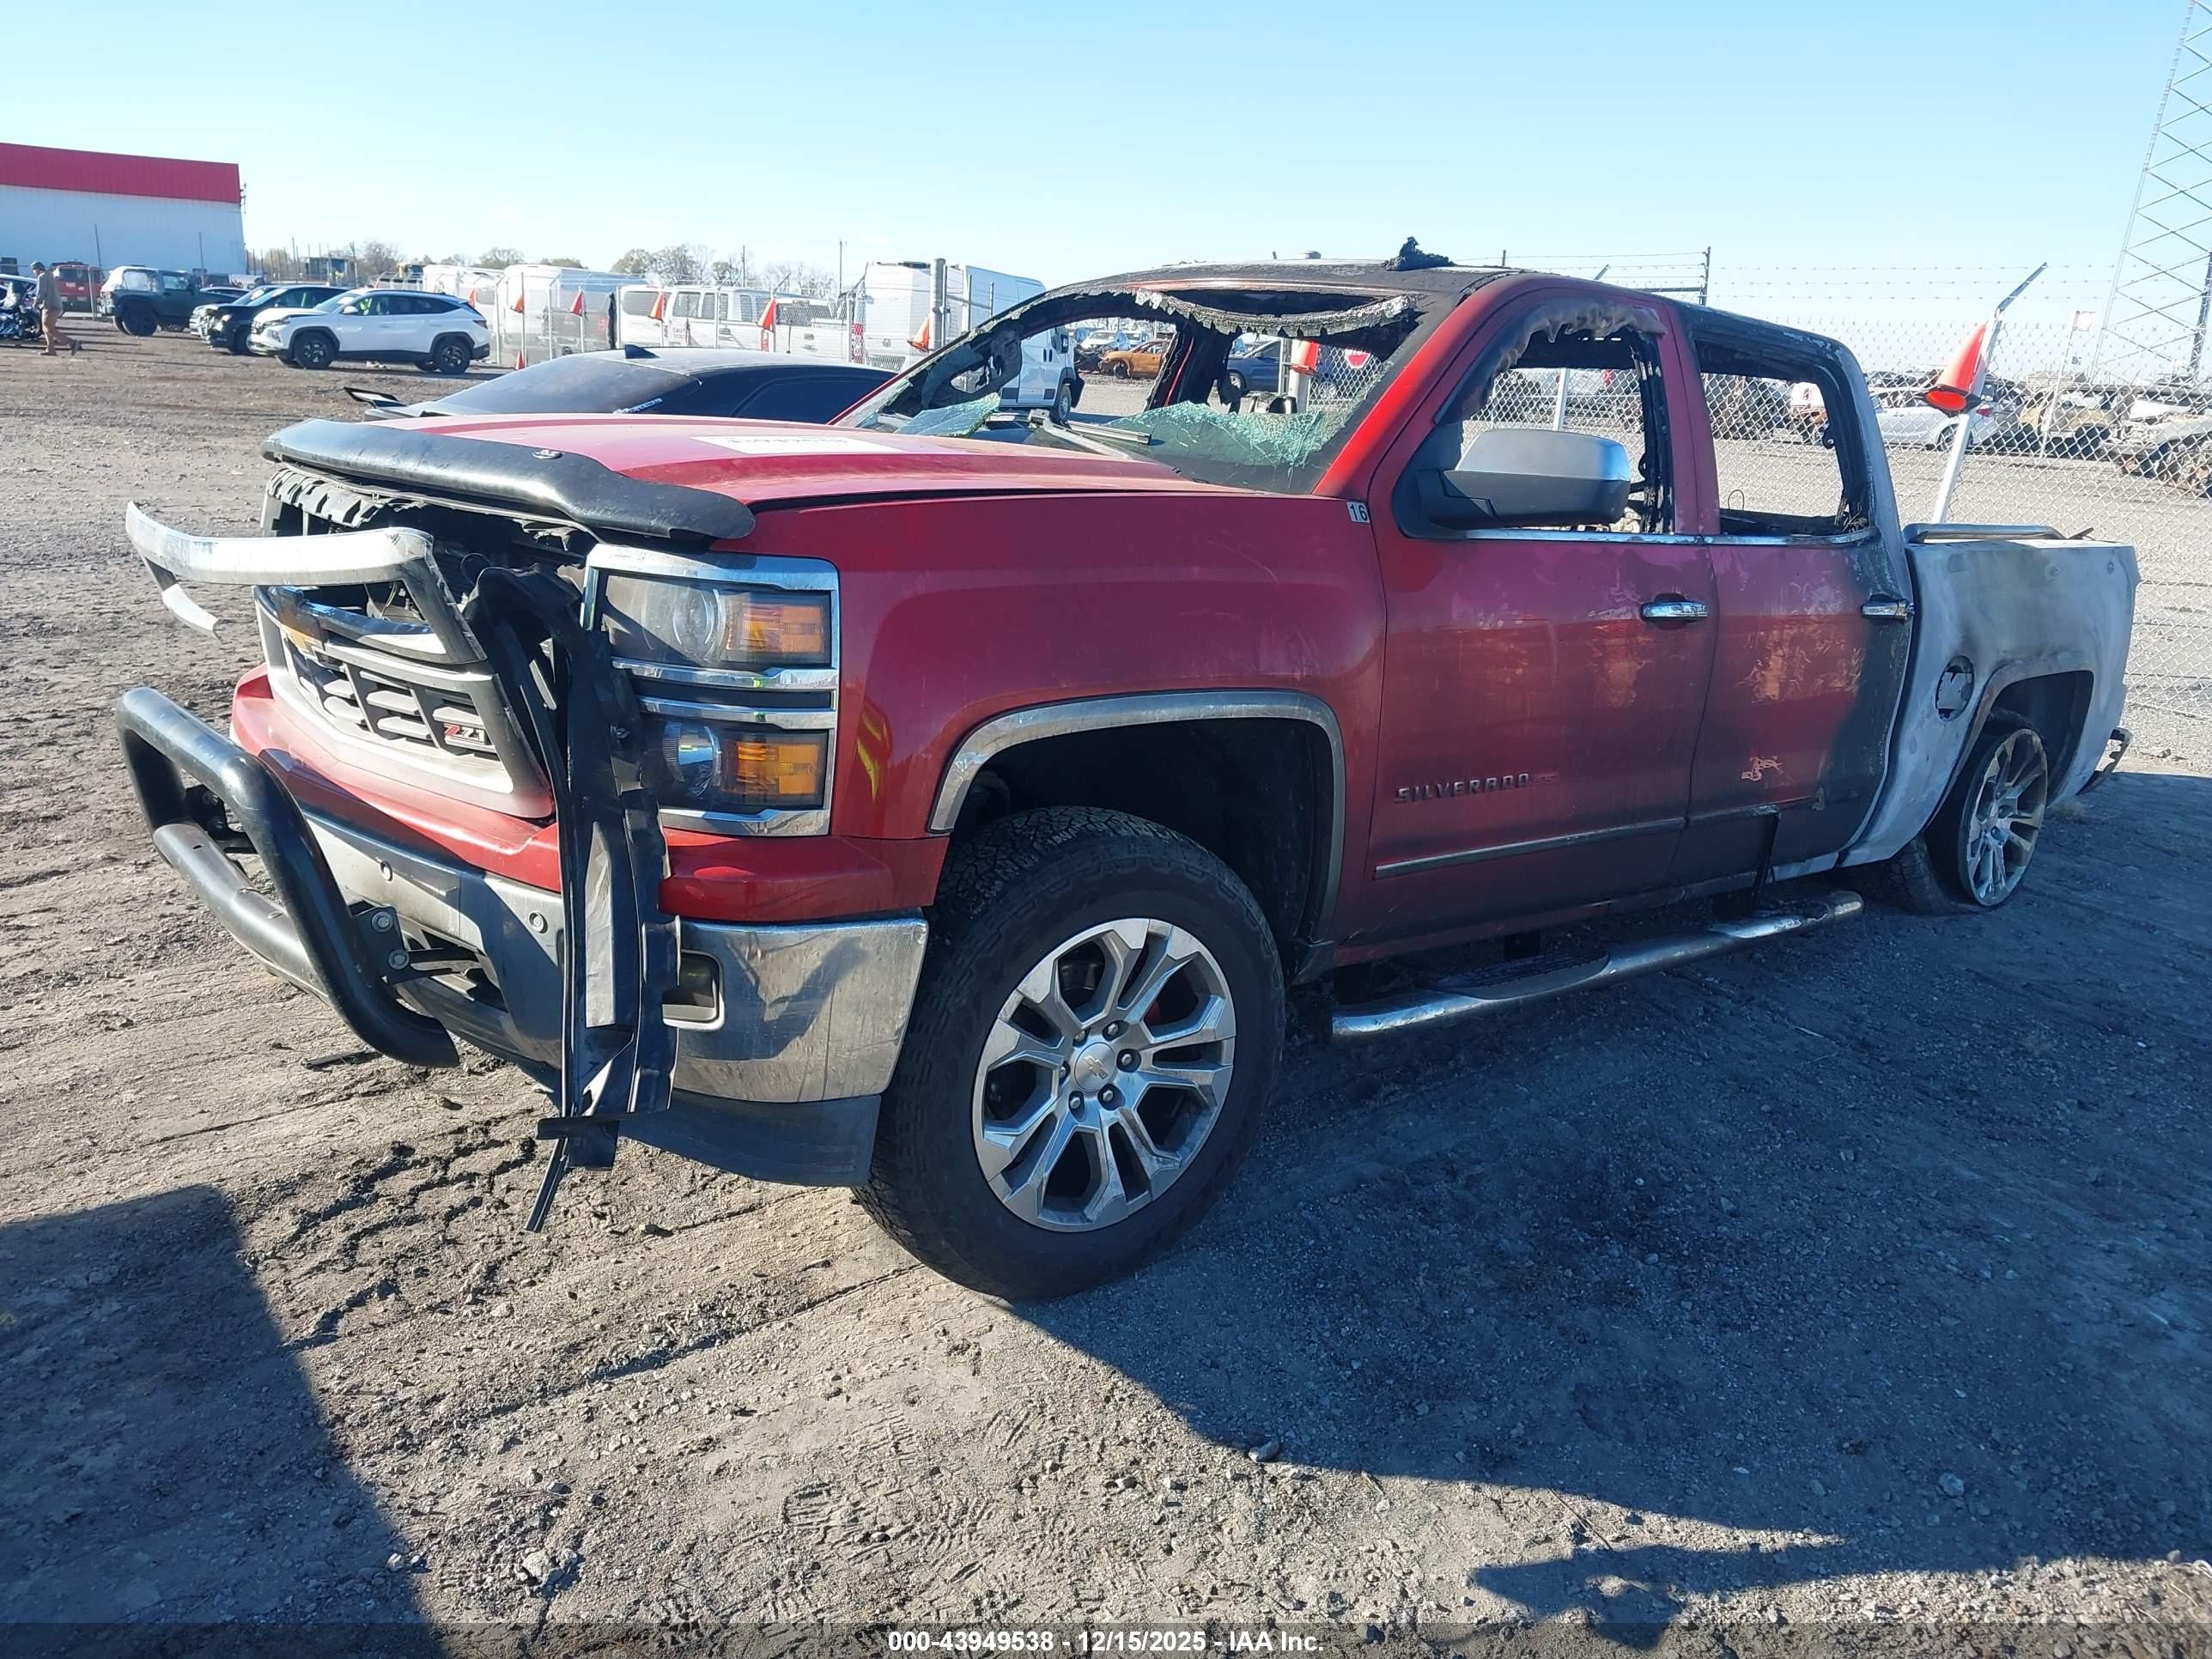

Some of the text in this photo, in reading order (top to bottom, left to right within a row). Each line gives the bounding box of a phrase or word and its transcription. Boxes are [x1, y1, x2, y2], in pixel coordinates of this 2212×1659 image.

[1350, 503, 1368, 521] 16
[443, 723, 485, 744] Z71
[1395, 773, 1530, 803] SILVERADO
